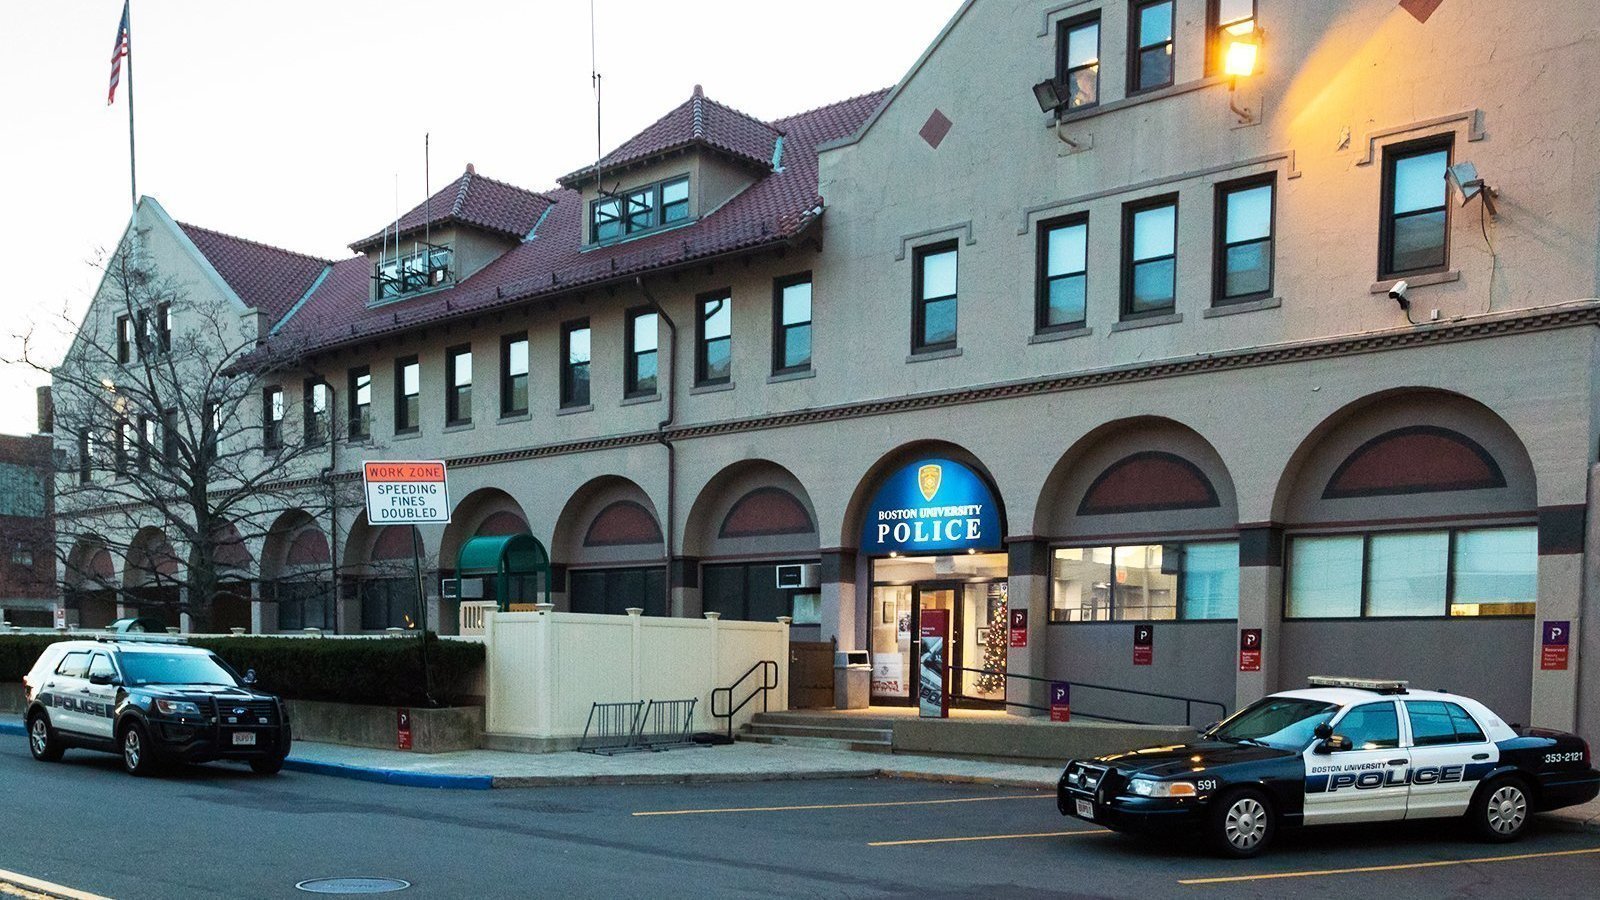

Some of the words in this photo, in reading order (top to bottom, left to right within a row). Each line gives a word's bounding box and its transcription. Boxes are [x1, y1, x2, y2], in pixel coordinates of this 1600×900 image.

[369, 467, 405, 478] WORK
[409, 467, 441, 478] ZONE
[377, 484, 437, 495] SPEEDING
[391, 496, 426, 506] FINES
[381, 508, 437, 519] DOUBLED
[878, 508, 918, 521] BOSTON
[920, 504, 983, 518] UNIVERSITY
[877, 518, 982, 544] POLICE
[53, 696, 106, 717] POLICE
[1544, 751, 1584, 763] 353-2121
[1311, 765, 1342, 774] BOSTON
[1344, 762, 1387, 772] UNIVERSITY
[1328, 764, 1464, 792] POLICE
[1197, 779, 1217, 790] 591
